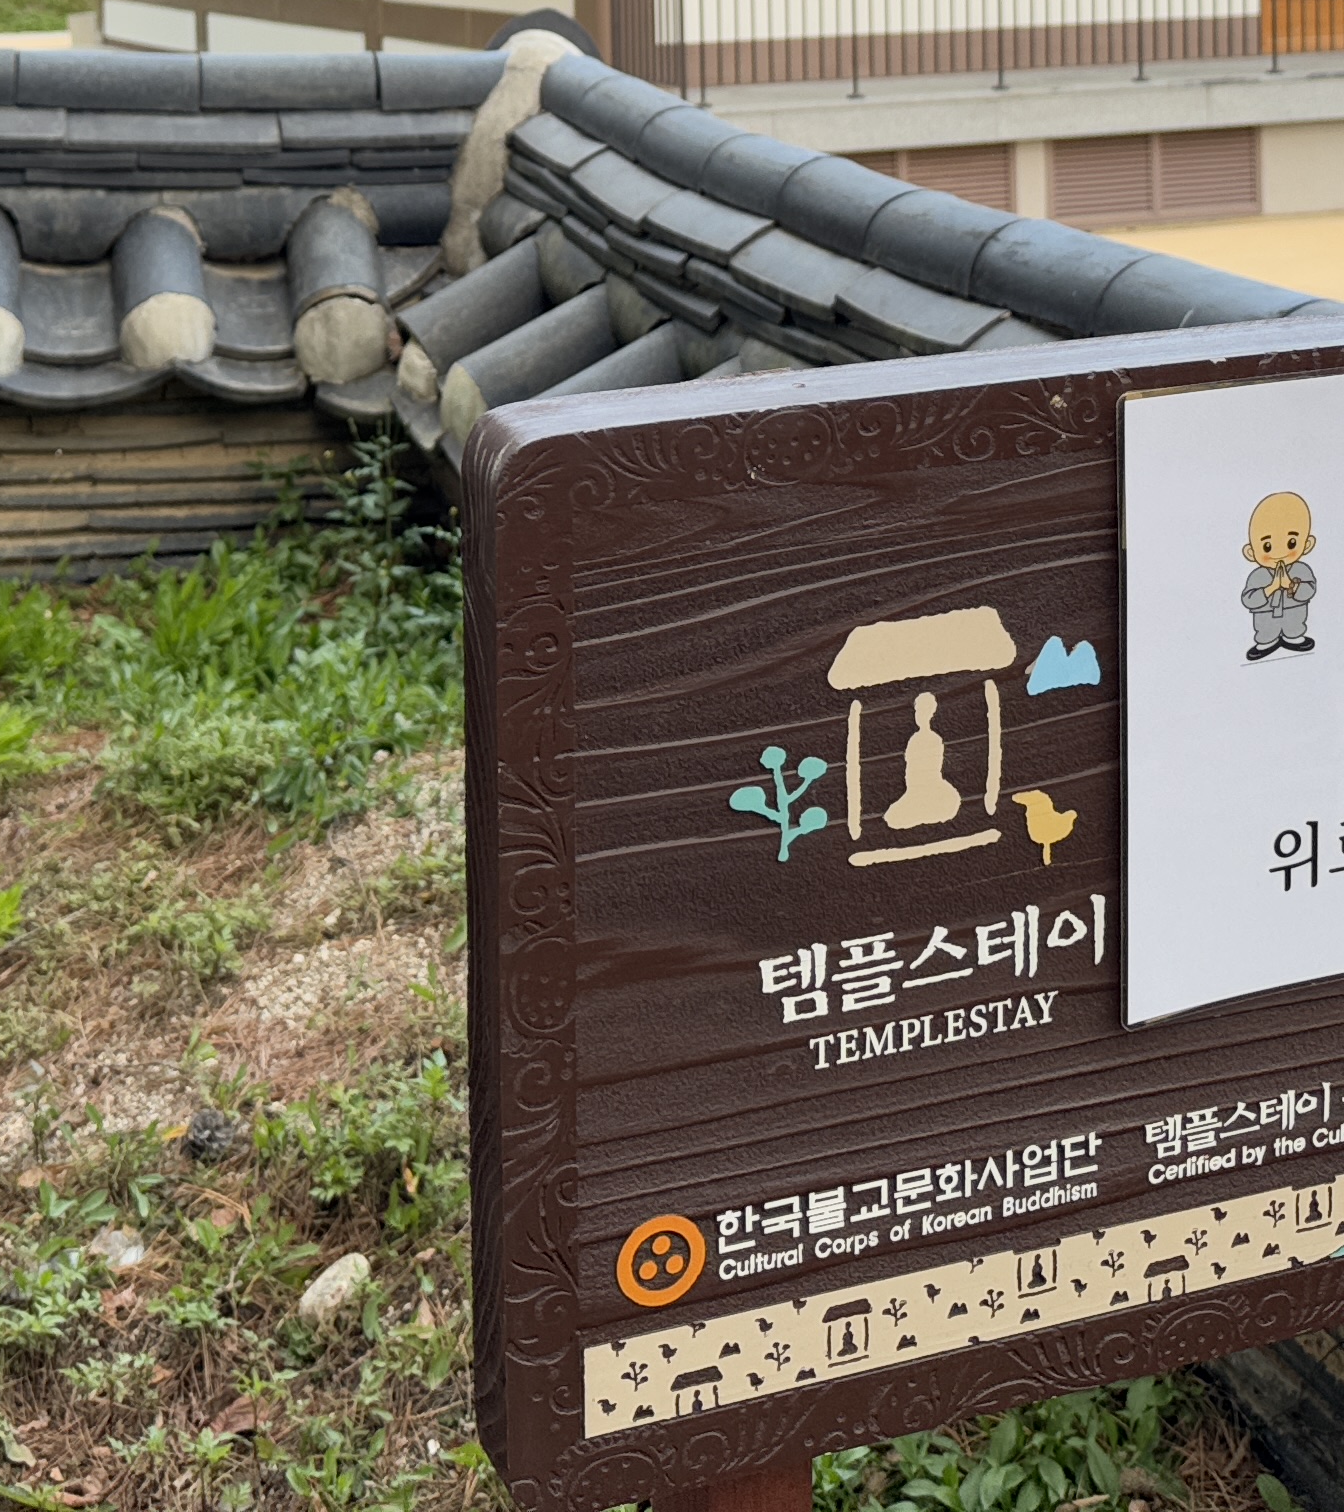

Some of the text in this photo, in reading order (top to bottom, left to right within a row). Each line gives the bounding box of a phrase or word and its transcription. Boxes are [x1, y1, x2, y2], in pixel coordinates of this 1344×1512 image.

[758, 893, 1106, 1024] 템플스테이
[809, 990, 1059, 1070] TEMPLESTAY
[1144, 1081, 1332, 1160] 템플스테이
[1241, 1145, 1267, 1166] by
[1273, 1136, 1307, 1157] the
[716, 1130, 1103, 1255] 한국불교문화사업단
[718, 1181, 1098, 1281] Cultural Corps of Korean Buddhism
